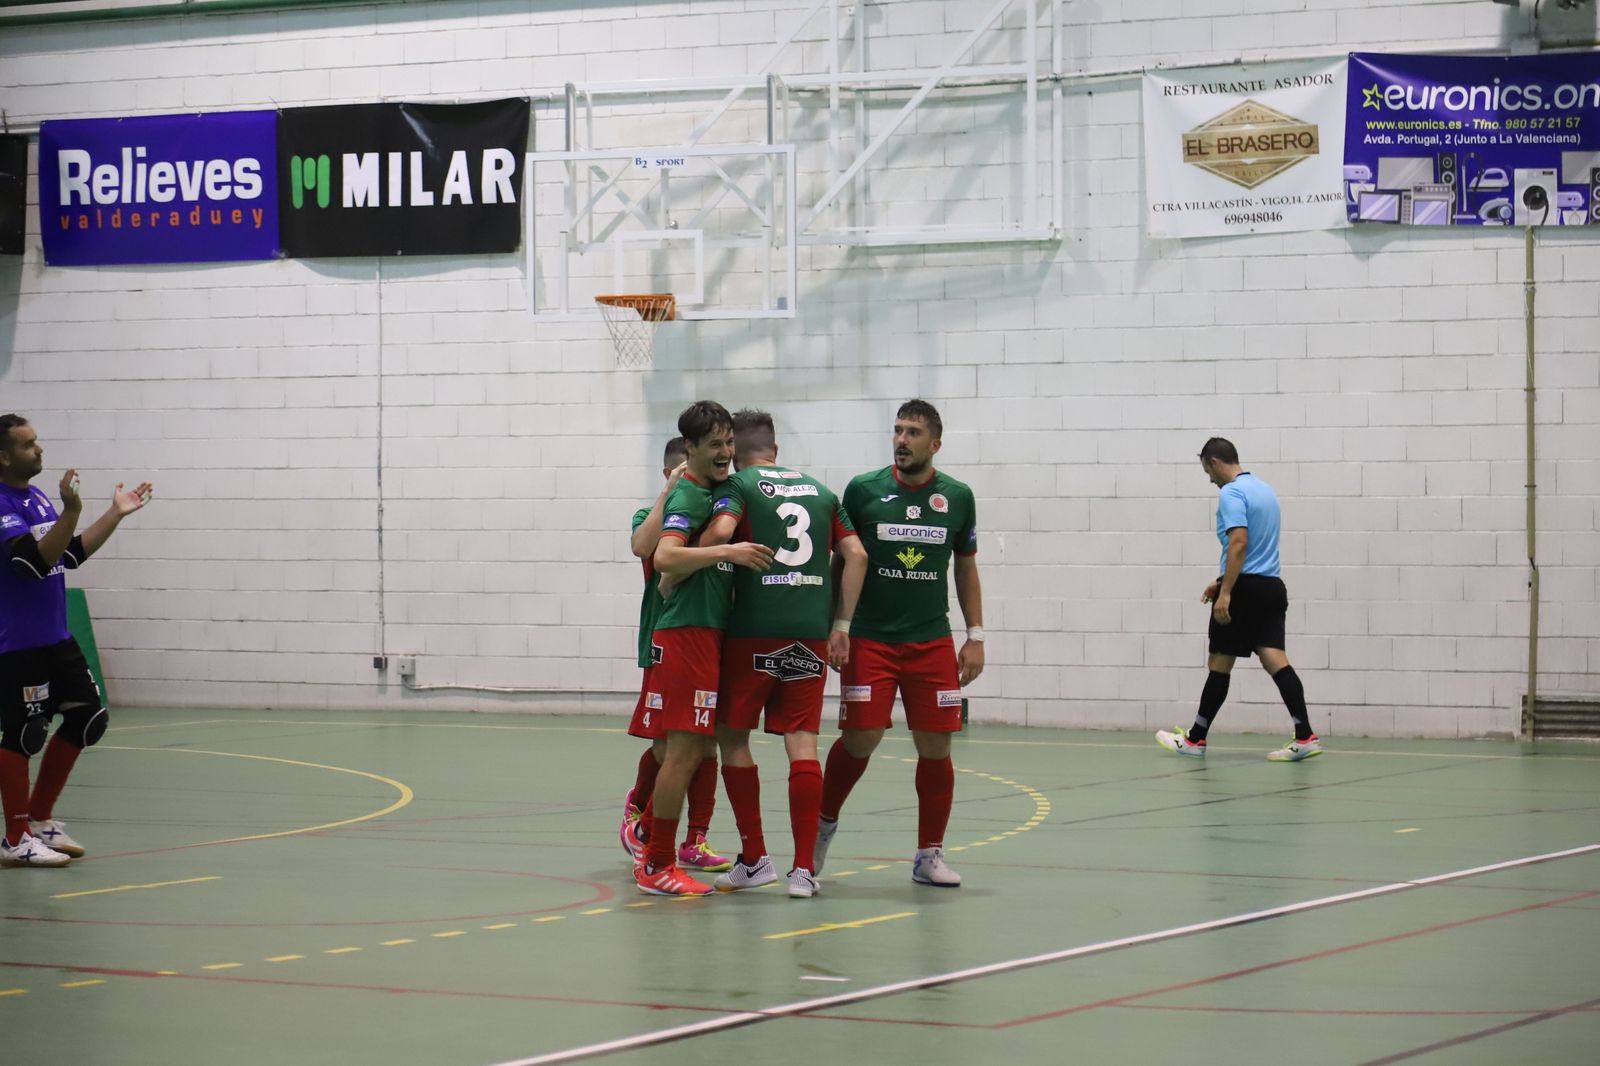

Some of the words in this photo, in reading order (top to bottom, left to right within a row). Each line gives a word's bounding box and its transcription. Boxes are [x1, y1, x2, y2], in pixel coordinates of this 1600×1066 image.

[1163, 79, 1267, 97] RESTAURANTE
[1273, 73, 1334, 90] ASADOR
[1365, 118, 1462, 129] www.euronics.es
[1505, 118, 1527, 130] 980
[1530, 117, 1544, 129] 57
[1549, 117, 1562, 129] 21
[1566, 116, 1581, 129] 57
[1186, 138, 1210, 156] EL
[1217, 131, 1314, 155] BRASERO
[1363, 133, 1394, 145] Avda.
[1397, 133, 1442, 146] Portugal,
[1445, 134, 1452, 144] 2
[1453, 133, 1488, 146] (Junto
[1490, 136, 1497, 144] a
[1499, 133, 1513, 144] La
[1515, 132, 1581, 145] Valenciana)
[656, 158, 685, 167] SPORT
[58, 146, 263, 206] Relieves
[342, 147, 517, 209] MILAR
[1152, 201, 1182, 212] CTRA
[60, 205, 264, 230] valderaduey
[1224, 210, 1283, 225] 696948046
[773, 502, 814, 567] 3
[888, 526, 945, 539] euronics
[878, 567, 904, 579] CAJA
[905, 570, 938, 580] RURAL
[765, 659, 778, 669] EL
[642, 711, 651, 728] 4
[694, 708, 710, 728] 14
